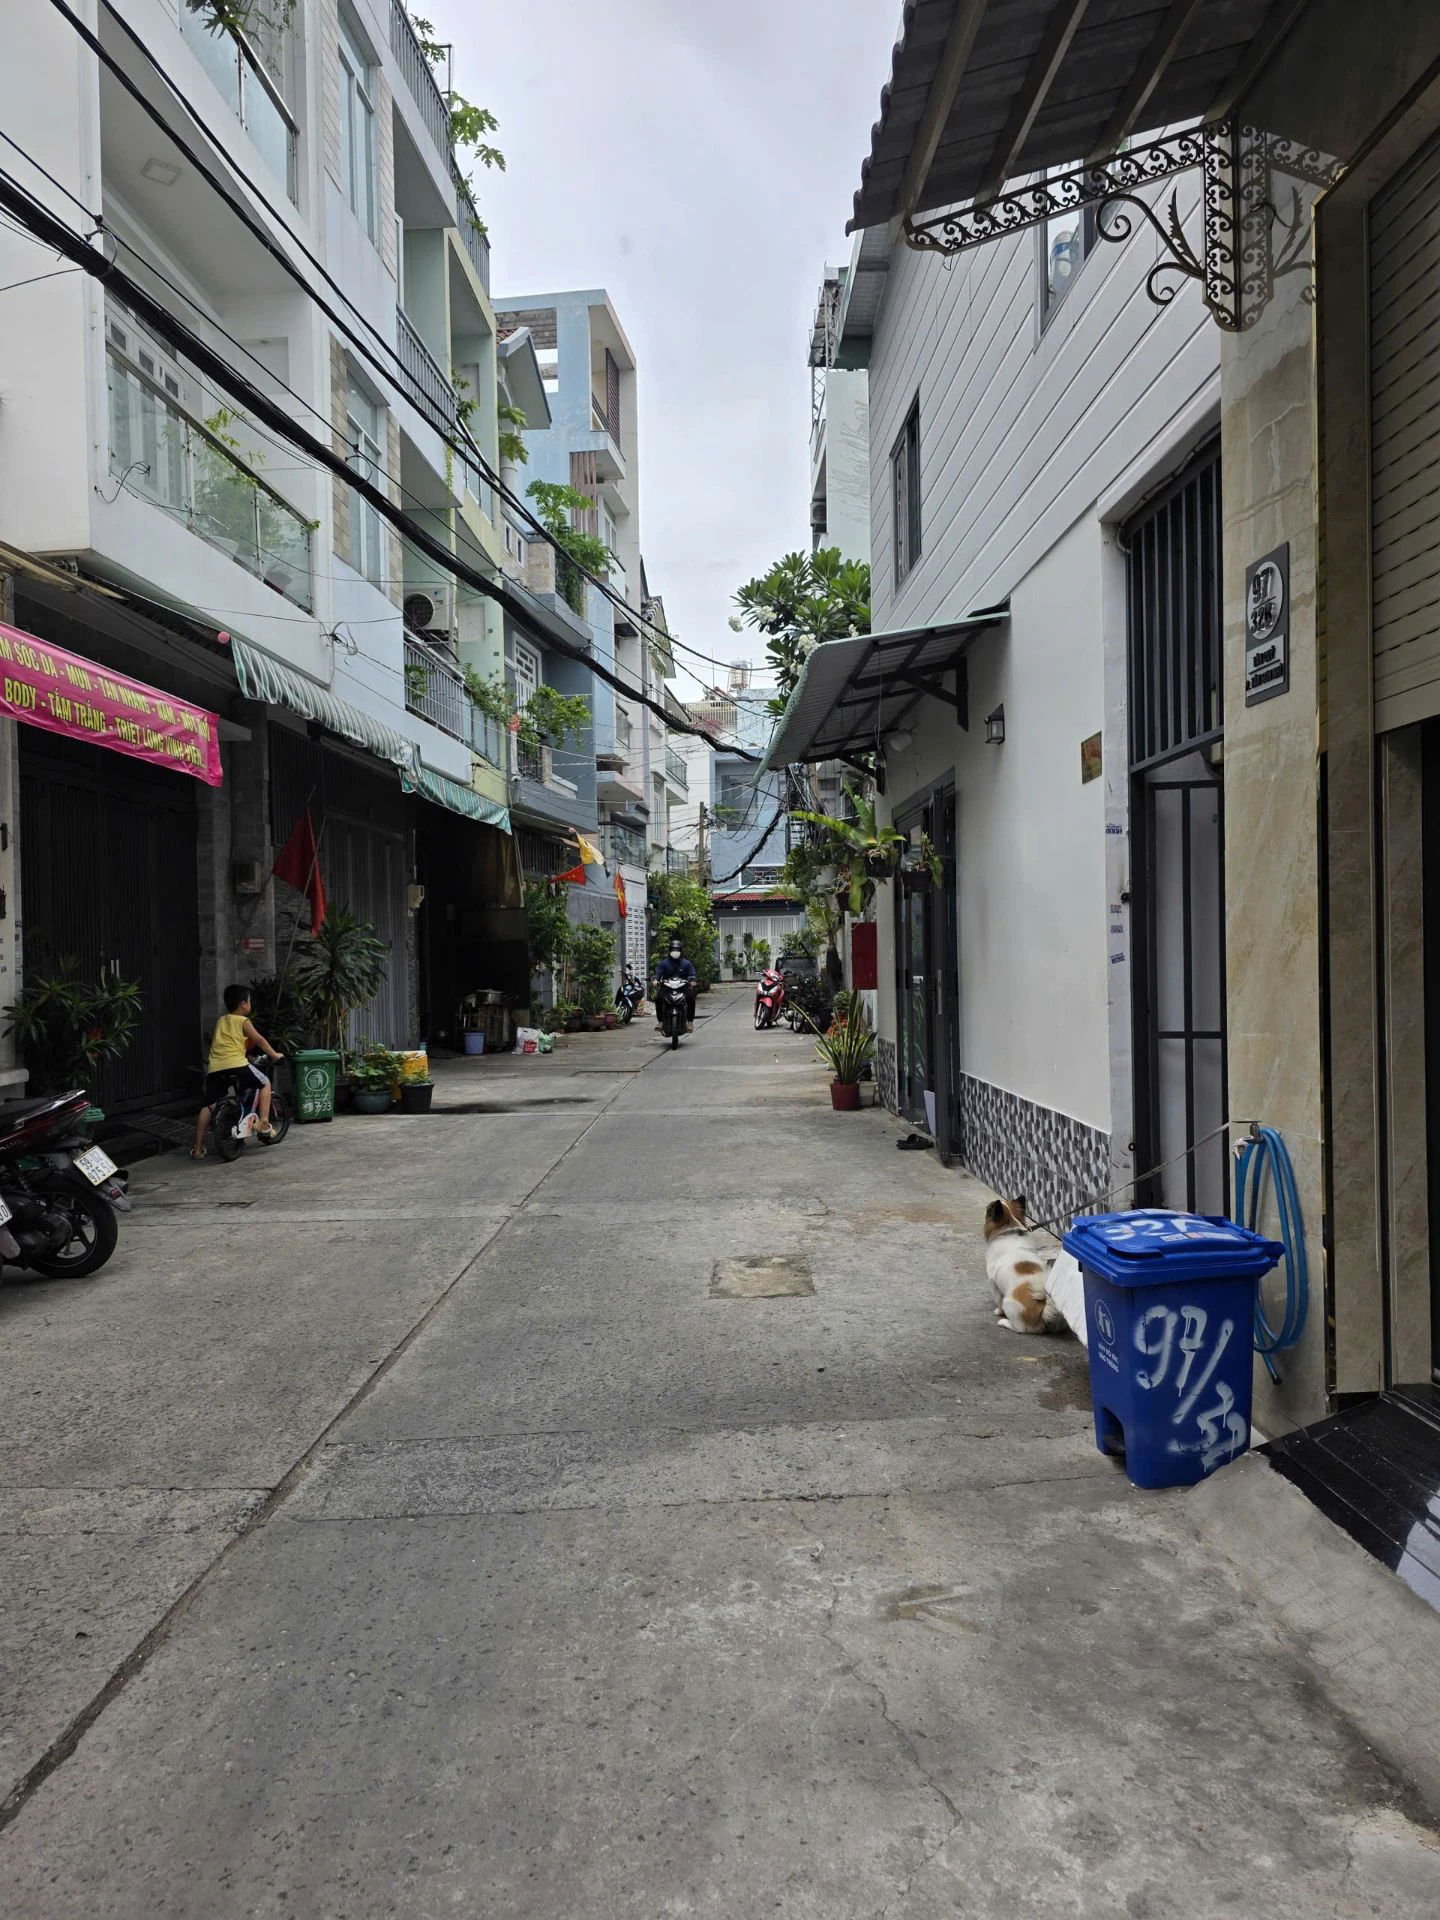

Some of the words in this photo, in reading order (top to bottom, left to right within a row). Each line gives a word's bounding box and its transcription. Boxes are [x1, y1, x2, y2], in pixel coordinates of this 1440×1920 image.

[1252, 566, 1274, 604] 97
[13, 640, 40, 671] SÓC
[40, 652, 58, 679] DA
[4, 677, 36, 711] BODY
